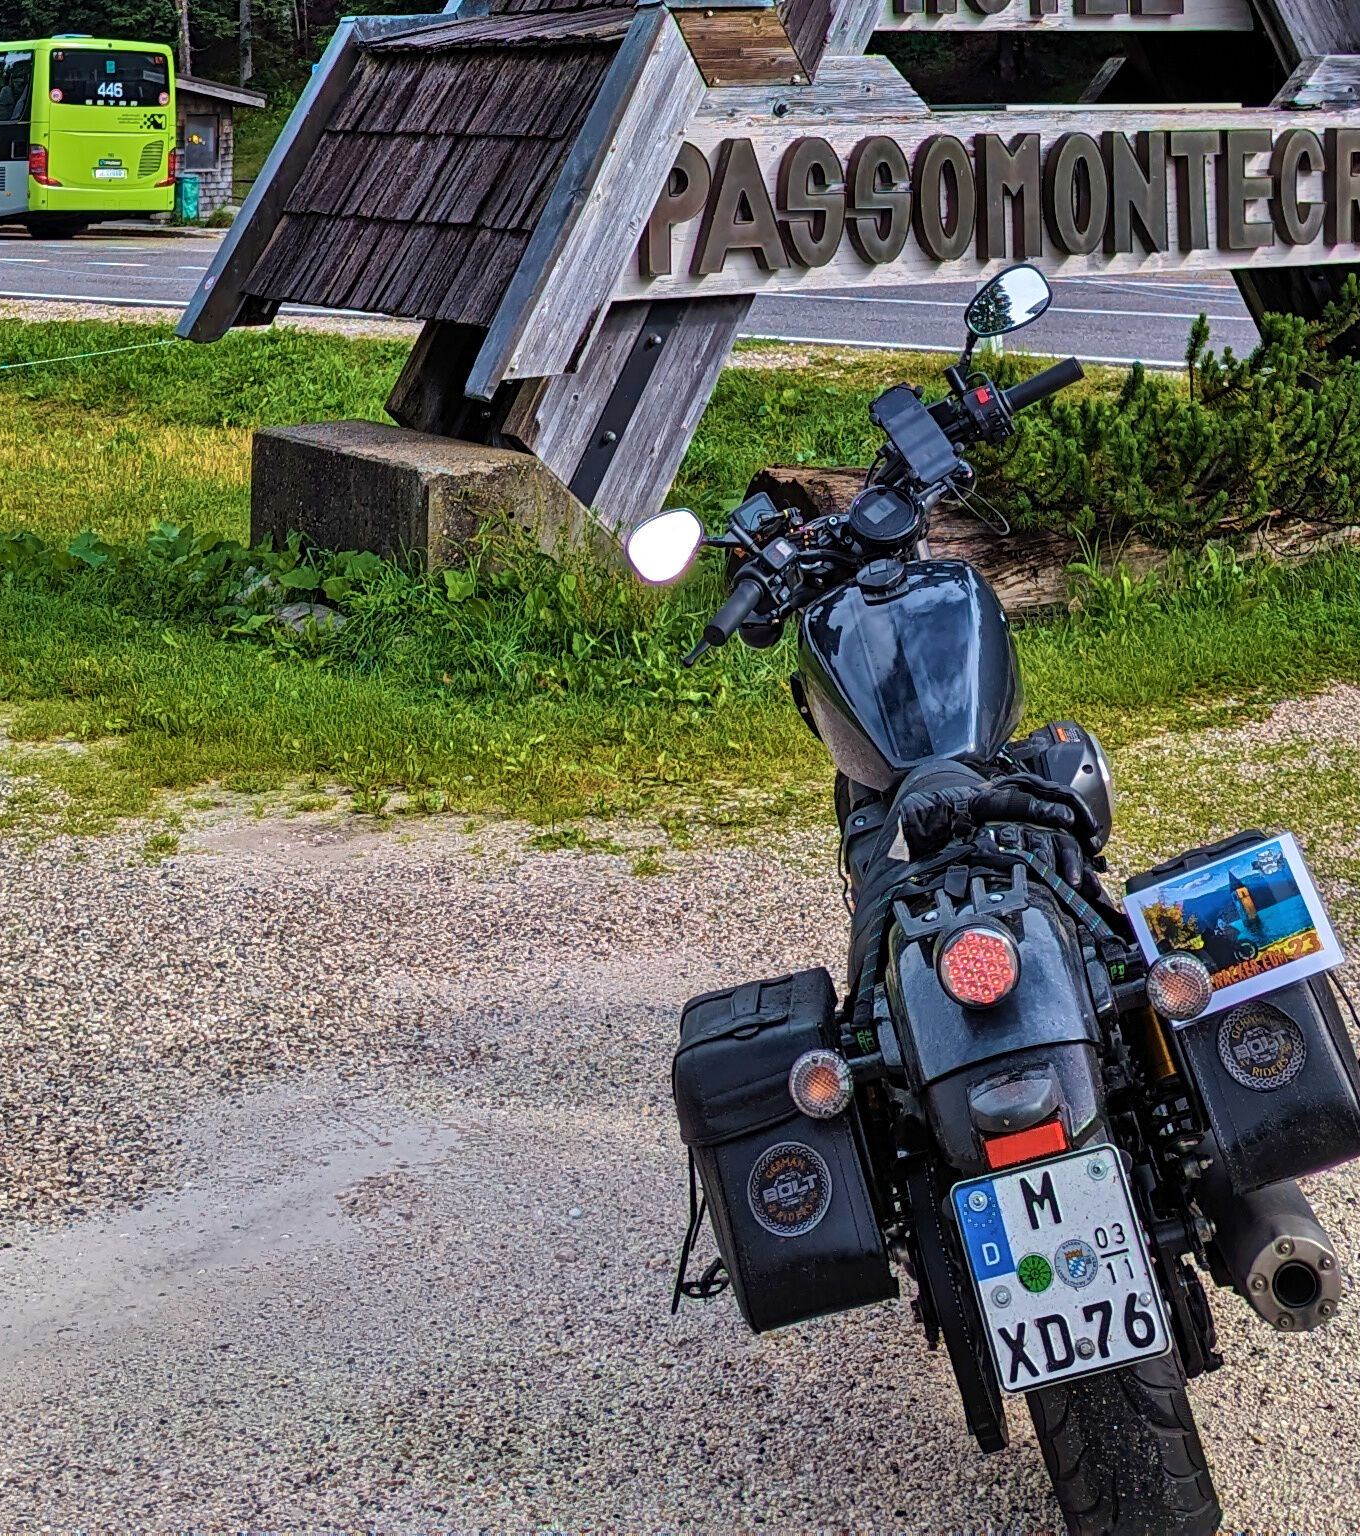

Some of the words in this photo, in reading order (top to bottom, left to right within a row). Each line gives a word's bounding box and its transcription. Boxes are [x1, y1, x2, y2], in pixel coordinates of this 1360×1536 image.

[97, 82, 123, 98] 446
[1288, 933, 1321, 959] 23
[1252, 1056, 1289, 1077] RIDERS
[762, 1174, 818, 1203] BOLT
[1019, 1171, 1062, 1230] M
[1094, 1223, 1126, 1249] 03
[982, 1242, 1000, 1266] D
[1106, 1258, 1135, 1285] 11
